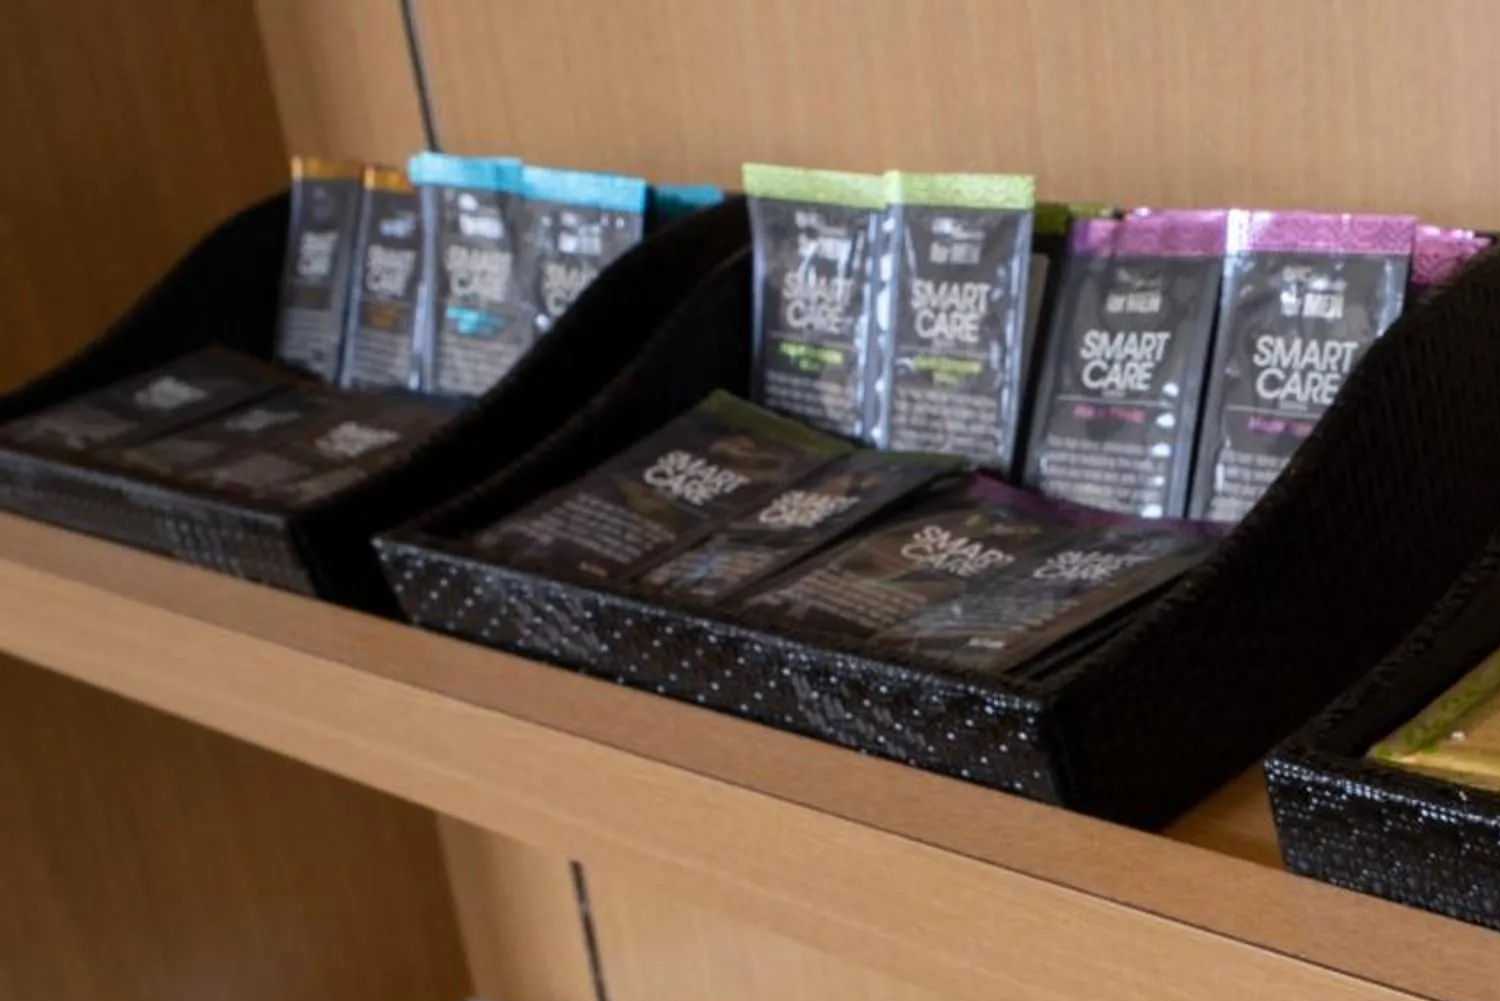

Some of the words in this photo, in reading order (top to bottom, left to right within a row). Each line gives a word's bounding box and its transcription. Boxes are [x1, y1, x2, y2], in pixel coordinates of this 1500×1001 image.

[911, 278, 991, 314] SMART
[785, 302, 844, 335] CARE
[914, 309, 980, 342] CARE
[1080, 329, 1171, 361] SMART
[1253, 335, 1358, 374] SMART
[1081, 359, 1155, 391] CARE
[1256, 368, 1342, 404] CARE
[656, 449, 751, 493] SMART
[912, 525, 1016, 564] SMART
